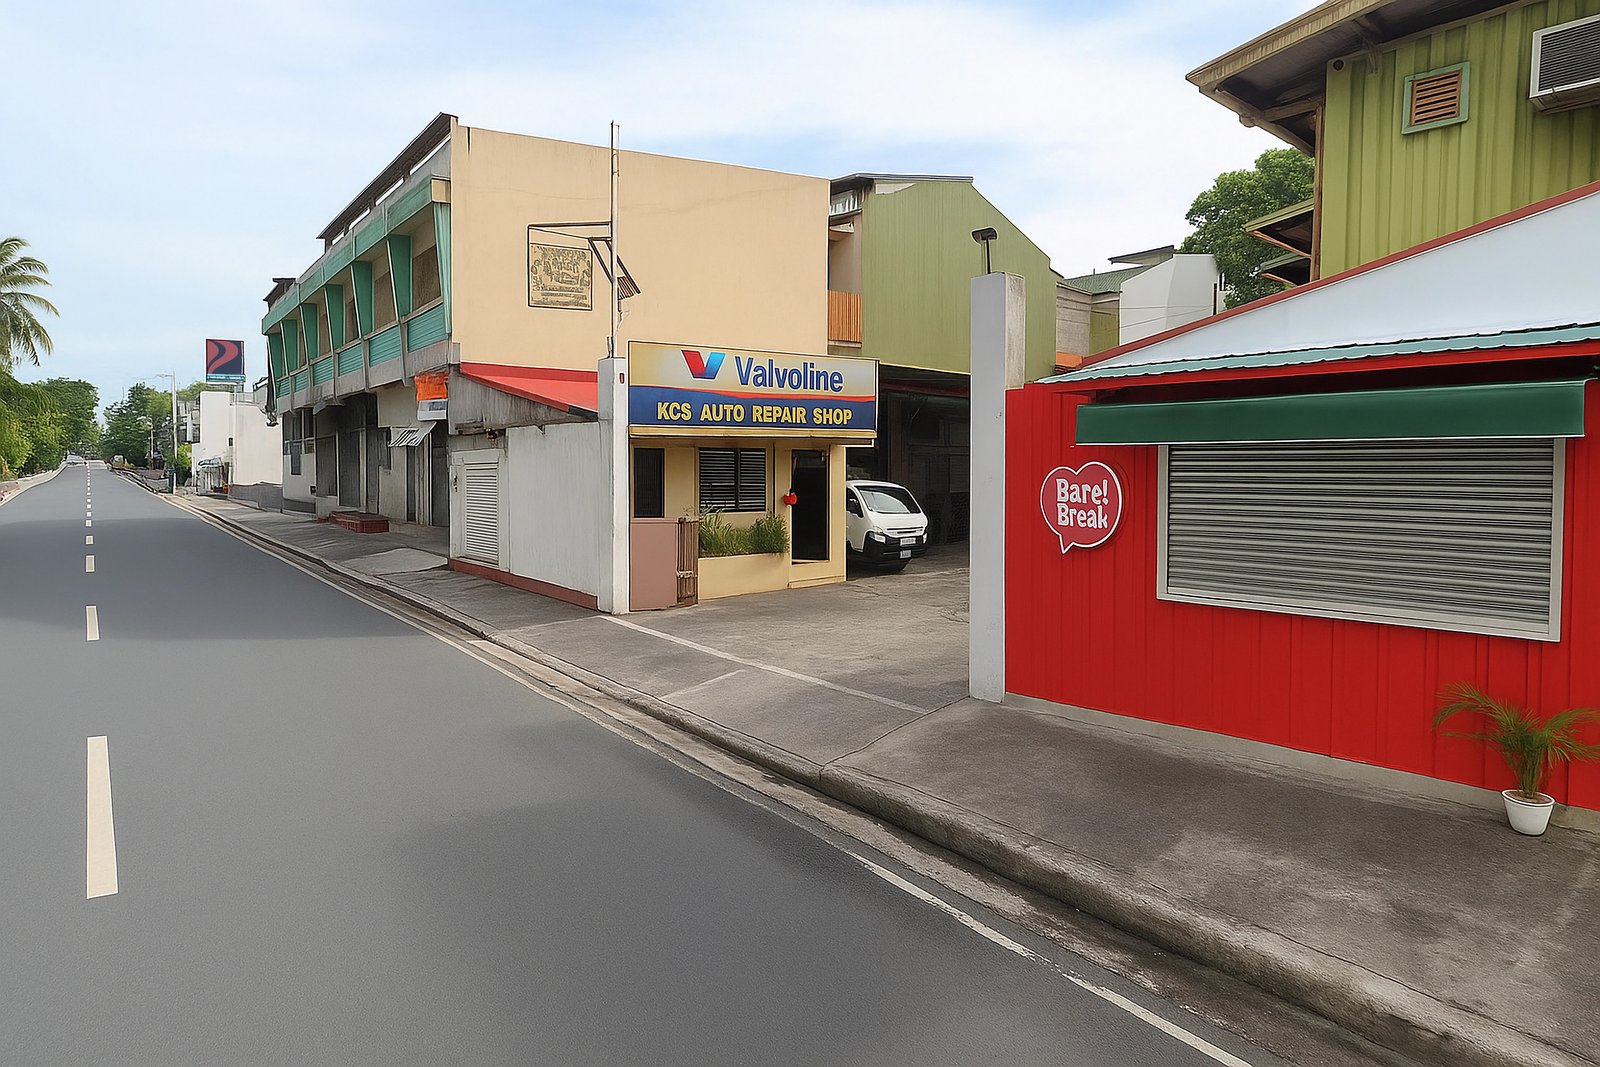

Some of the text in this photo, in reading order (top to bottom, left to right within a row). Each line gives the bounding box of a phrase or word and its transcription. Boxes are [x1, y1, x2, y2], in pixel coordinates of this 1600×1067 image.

[734, 355, 844, 392] Valvoline
[657, 401, 853, 425] KCS AUTO REPAIR SHOP
[1056, 478, 1109, 505] Bare!
[1056, 503, 1108, 529] Break
